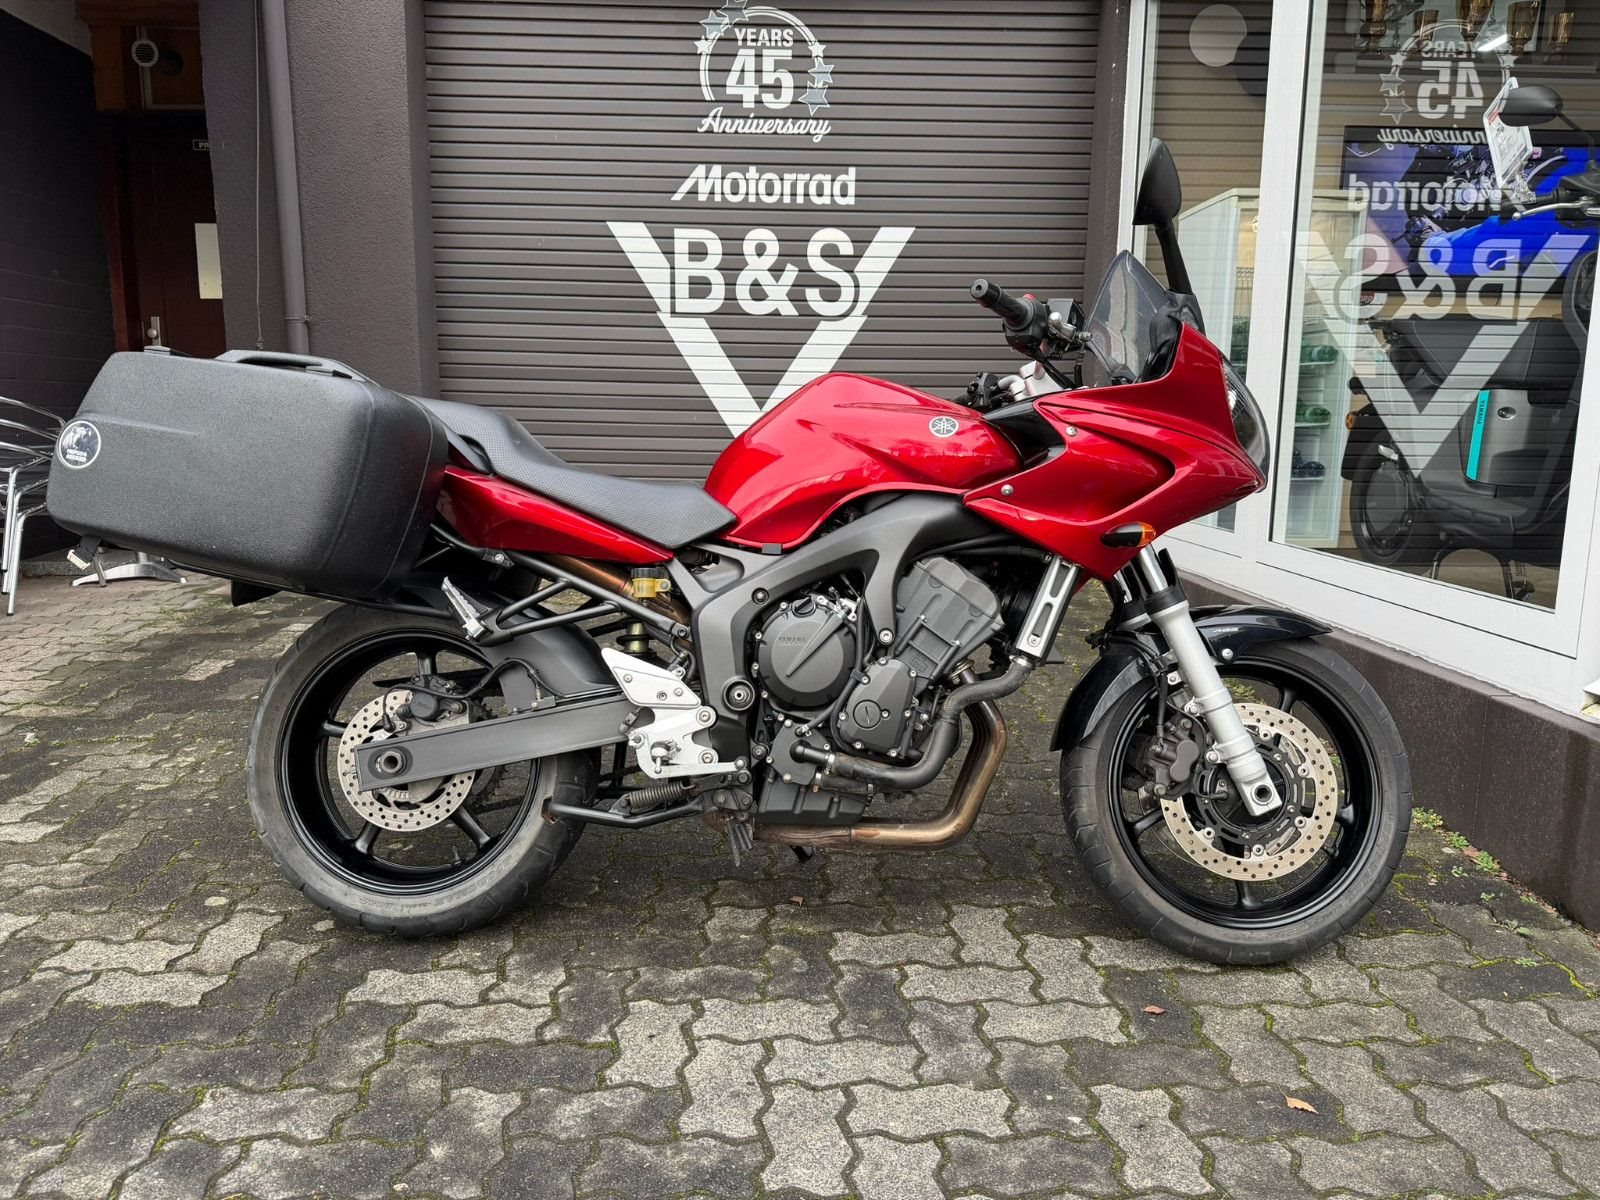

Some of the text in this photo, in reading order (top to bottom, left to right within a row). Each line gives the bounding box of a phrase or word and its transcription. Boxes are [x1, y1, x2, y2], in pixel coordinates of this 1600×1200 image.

[734, 28, 794, 47] YEARS
[726, 48, 794, 110] 45
[697, 107, 831, 143] Anniversary
[671, 164, 856, 206] Motorrad
[673, 227, 857, 317] B&S
